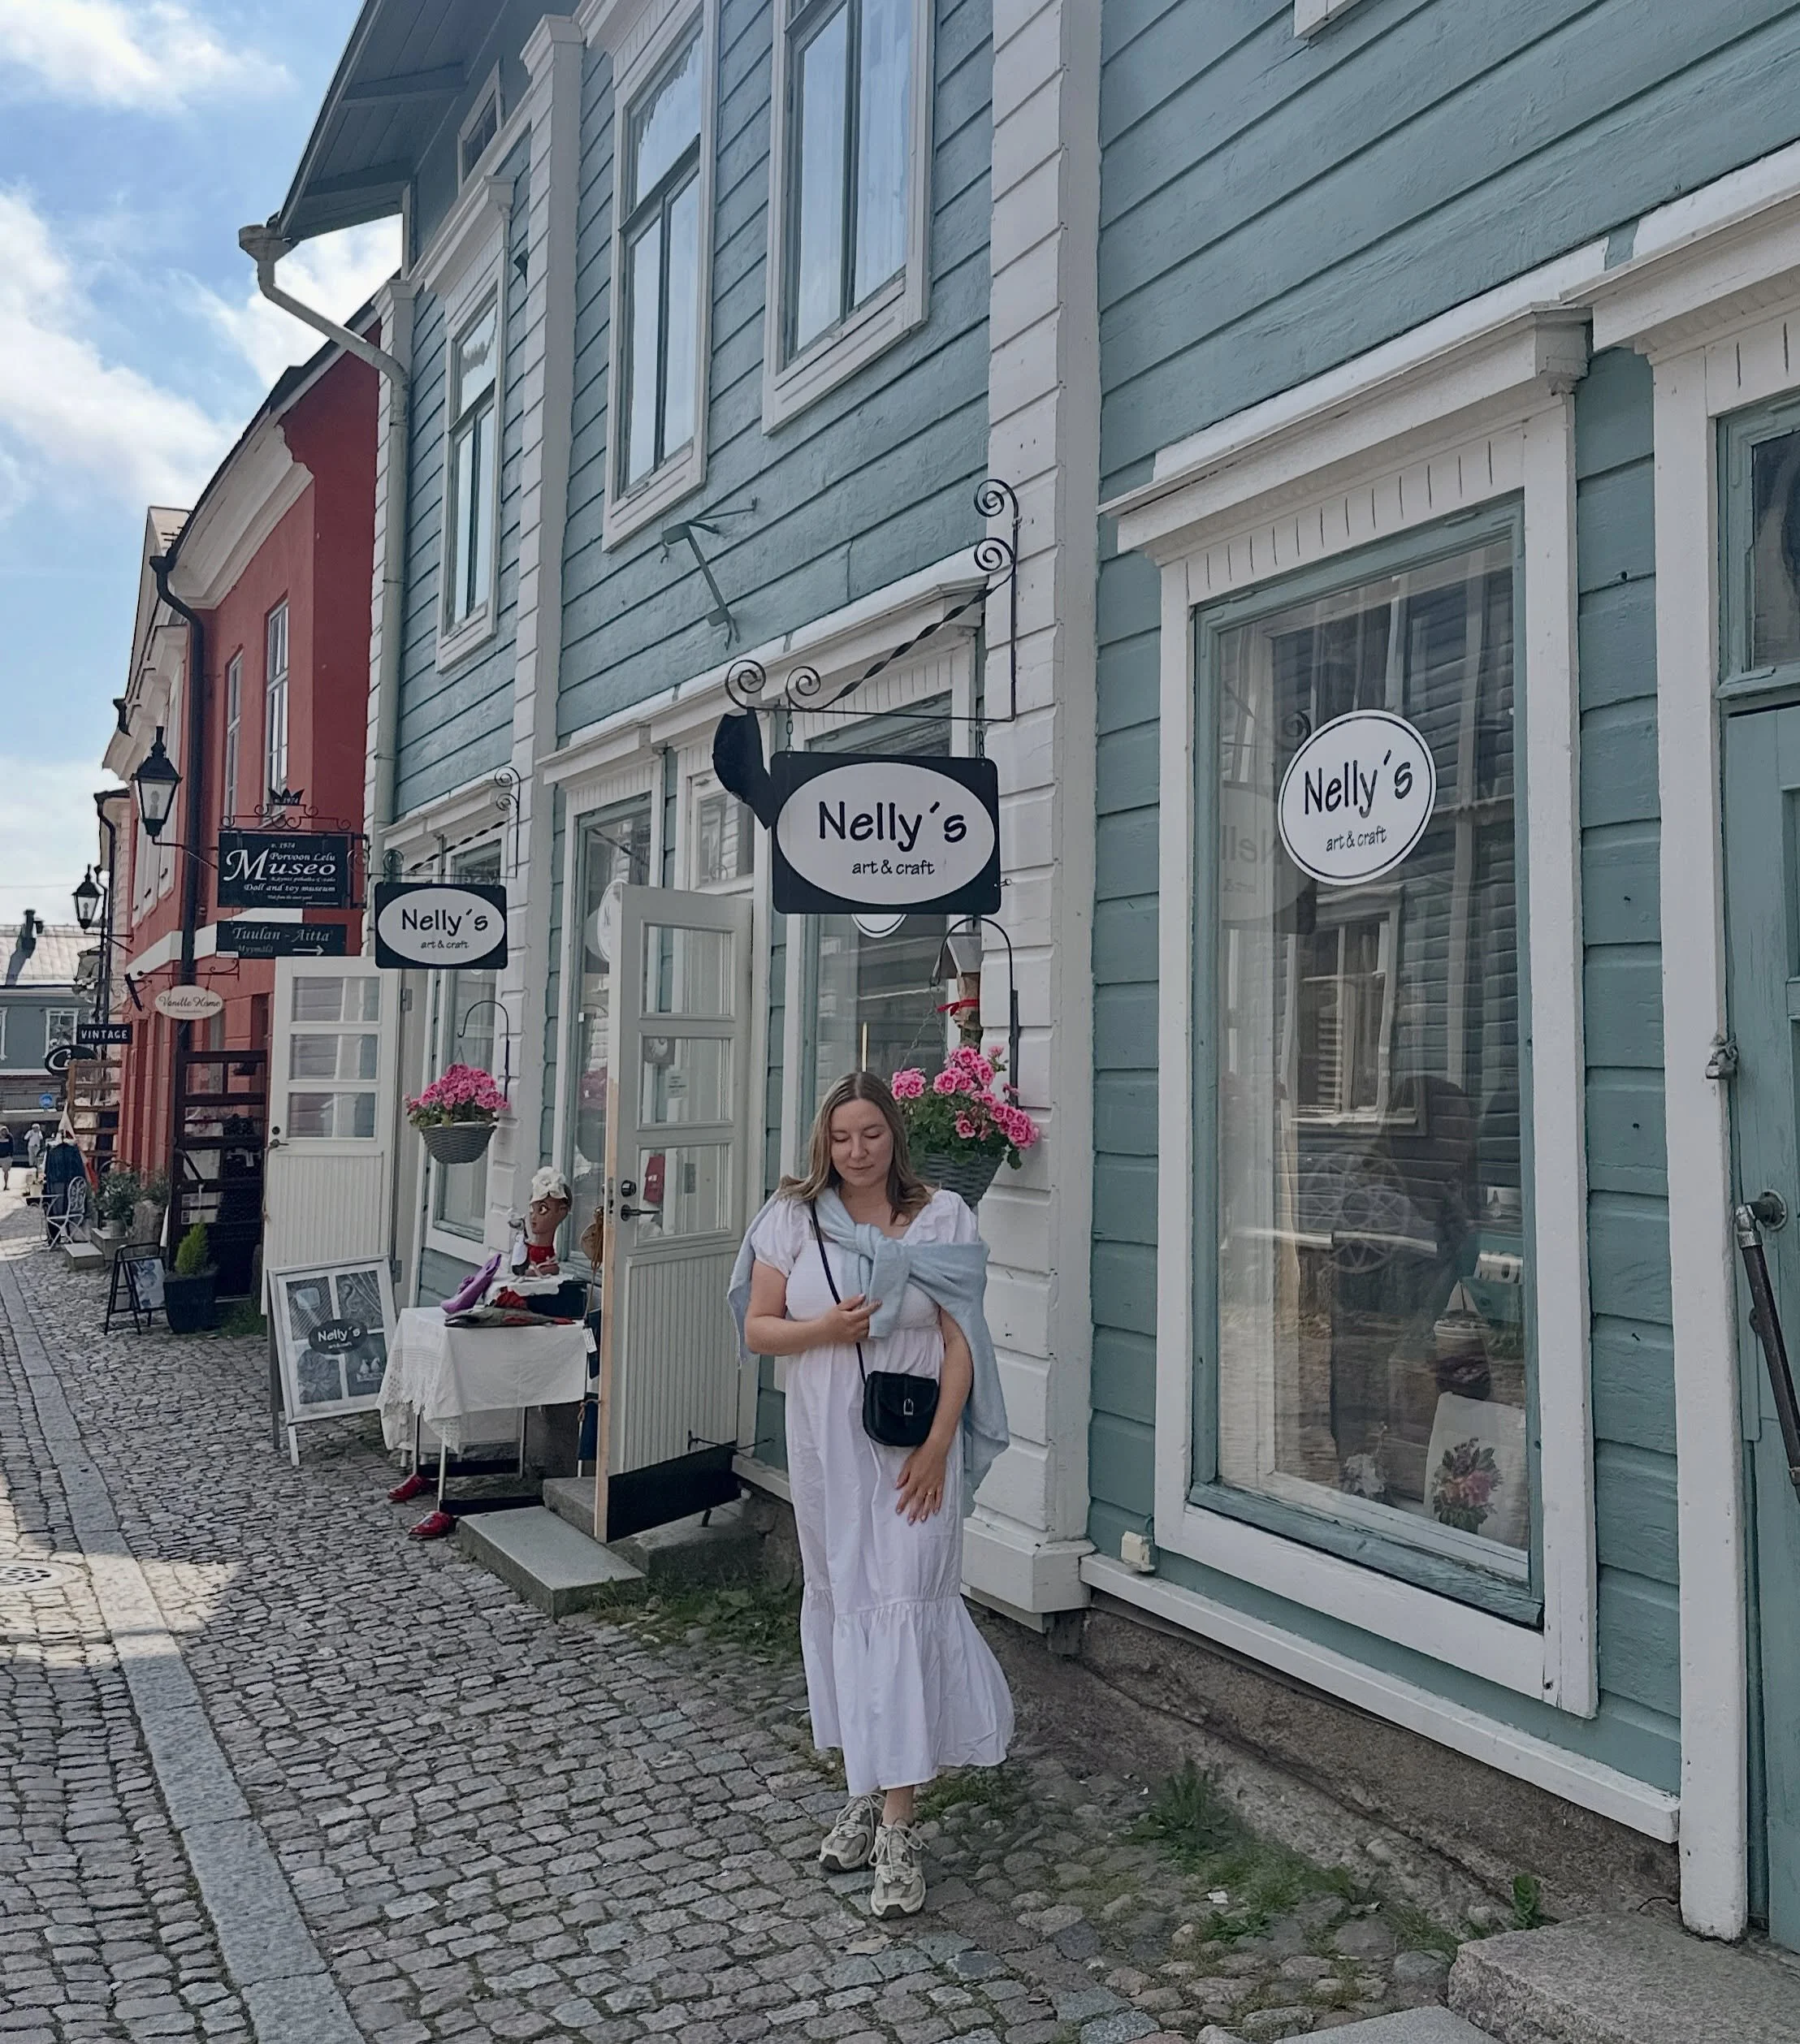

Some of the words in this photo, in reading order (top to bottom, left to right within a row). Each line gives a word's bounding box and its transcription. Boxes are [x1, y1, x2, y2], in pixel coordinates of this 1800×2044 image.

[1326, 833, 1344, 852] art
[1346, 831, 1356, 848] &
[1357, 825, 1387, 847] craft
[270, 852, 310, 861] Porvoon
[313, 852, 335, 861] Lelu
[223, 848, 335, 881] Museo
[852, 861, 878, 875] art
[881, 859, 893, 874] &
[896, 859, 935, 875] craft
[244, 883, 266, 892] Doll
[266, 883, 285, 891] and
[285, 885, 300, 893] toy
[232, 926, 281, 940] Tuulan
[291, 928, 330, 943] Aitta
[421, 940, 436, 949] art
[437, 940, 444, 949] &
[446, 940, 469, 949] craft
[81, 1029, 128, 1039] VINTAGE
